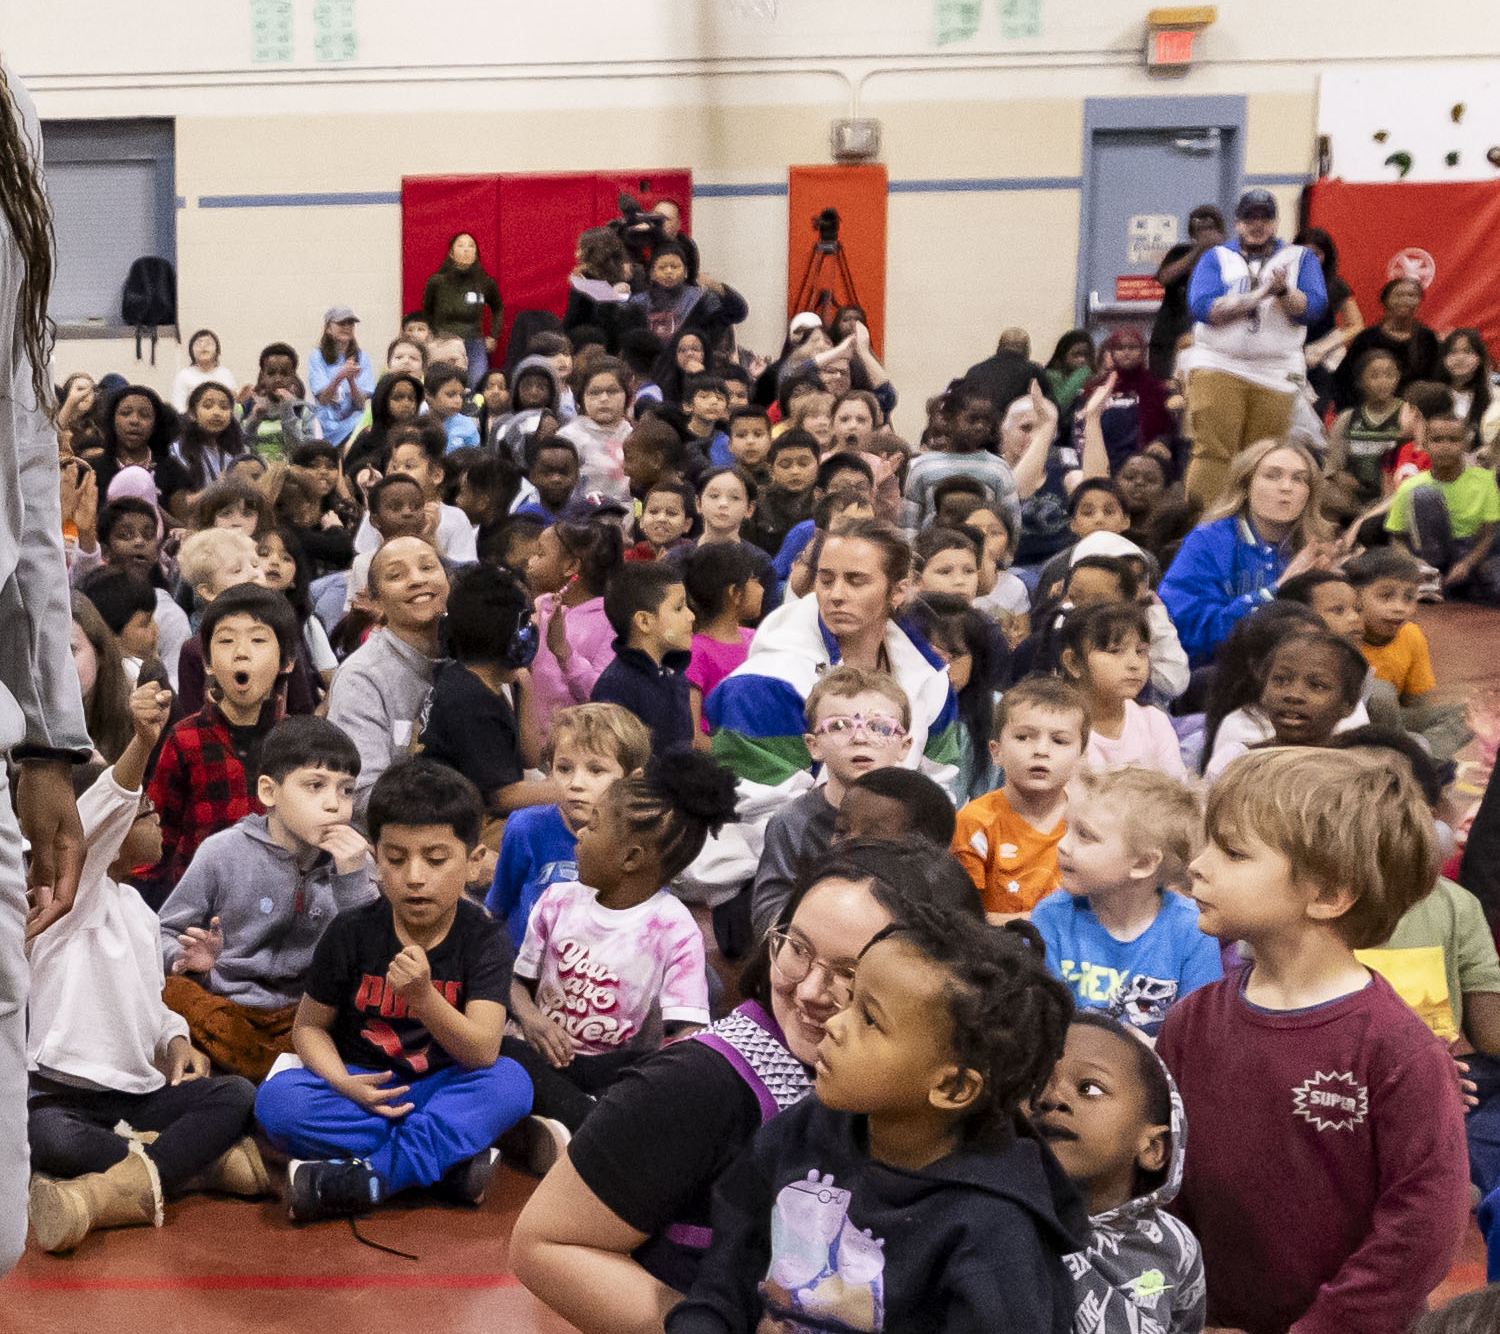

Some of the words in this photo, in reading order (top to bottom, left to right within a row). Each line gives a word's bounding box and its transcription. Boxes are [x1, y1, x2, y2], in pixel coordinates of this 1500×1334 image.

[557, 938, 620, 985] You
[354, 973, 463, 1019] PU
[563, 976, 617, 1010] are
[566, 994, 588, 1014] so
[1310, 1090, 1357, 1113] SUPER
